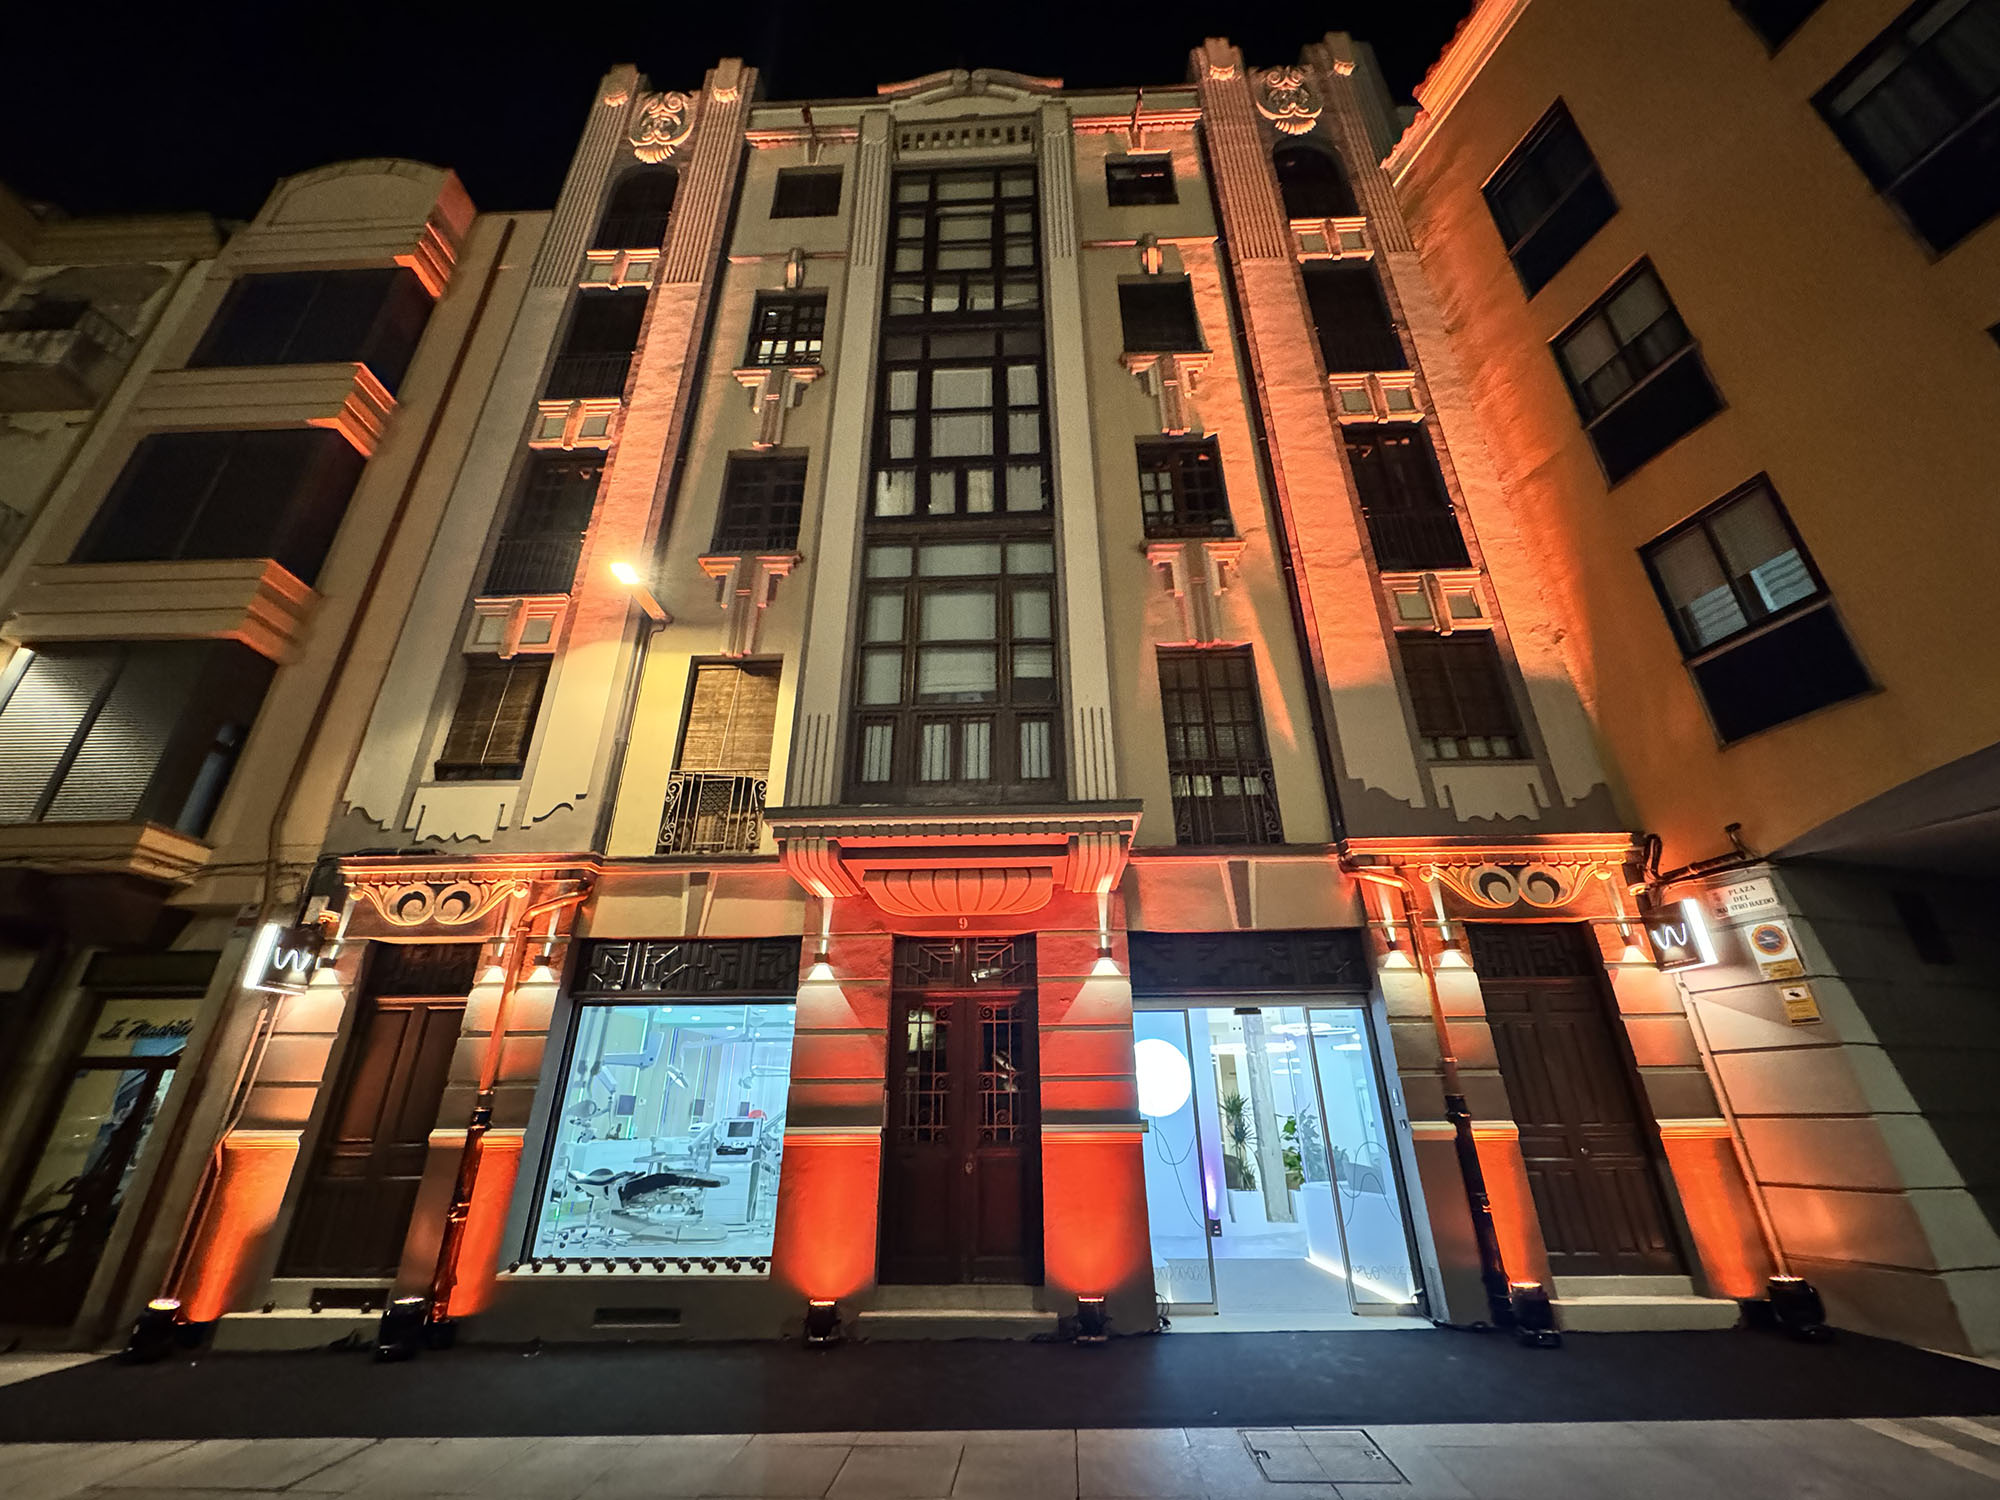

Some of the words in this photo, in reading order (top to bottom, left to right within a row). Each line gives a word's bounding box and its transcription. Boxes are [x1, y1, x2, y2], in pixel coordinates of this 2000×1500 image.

[1728, 885, 1756, 896] PLAZA
[1733, 895, 1750, 903] DEL
[958, 916, 968, 930] 9
